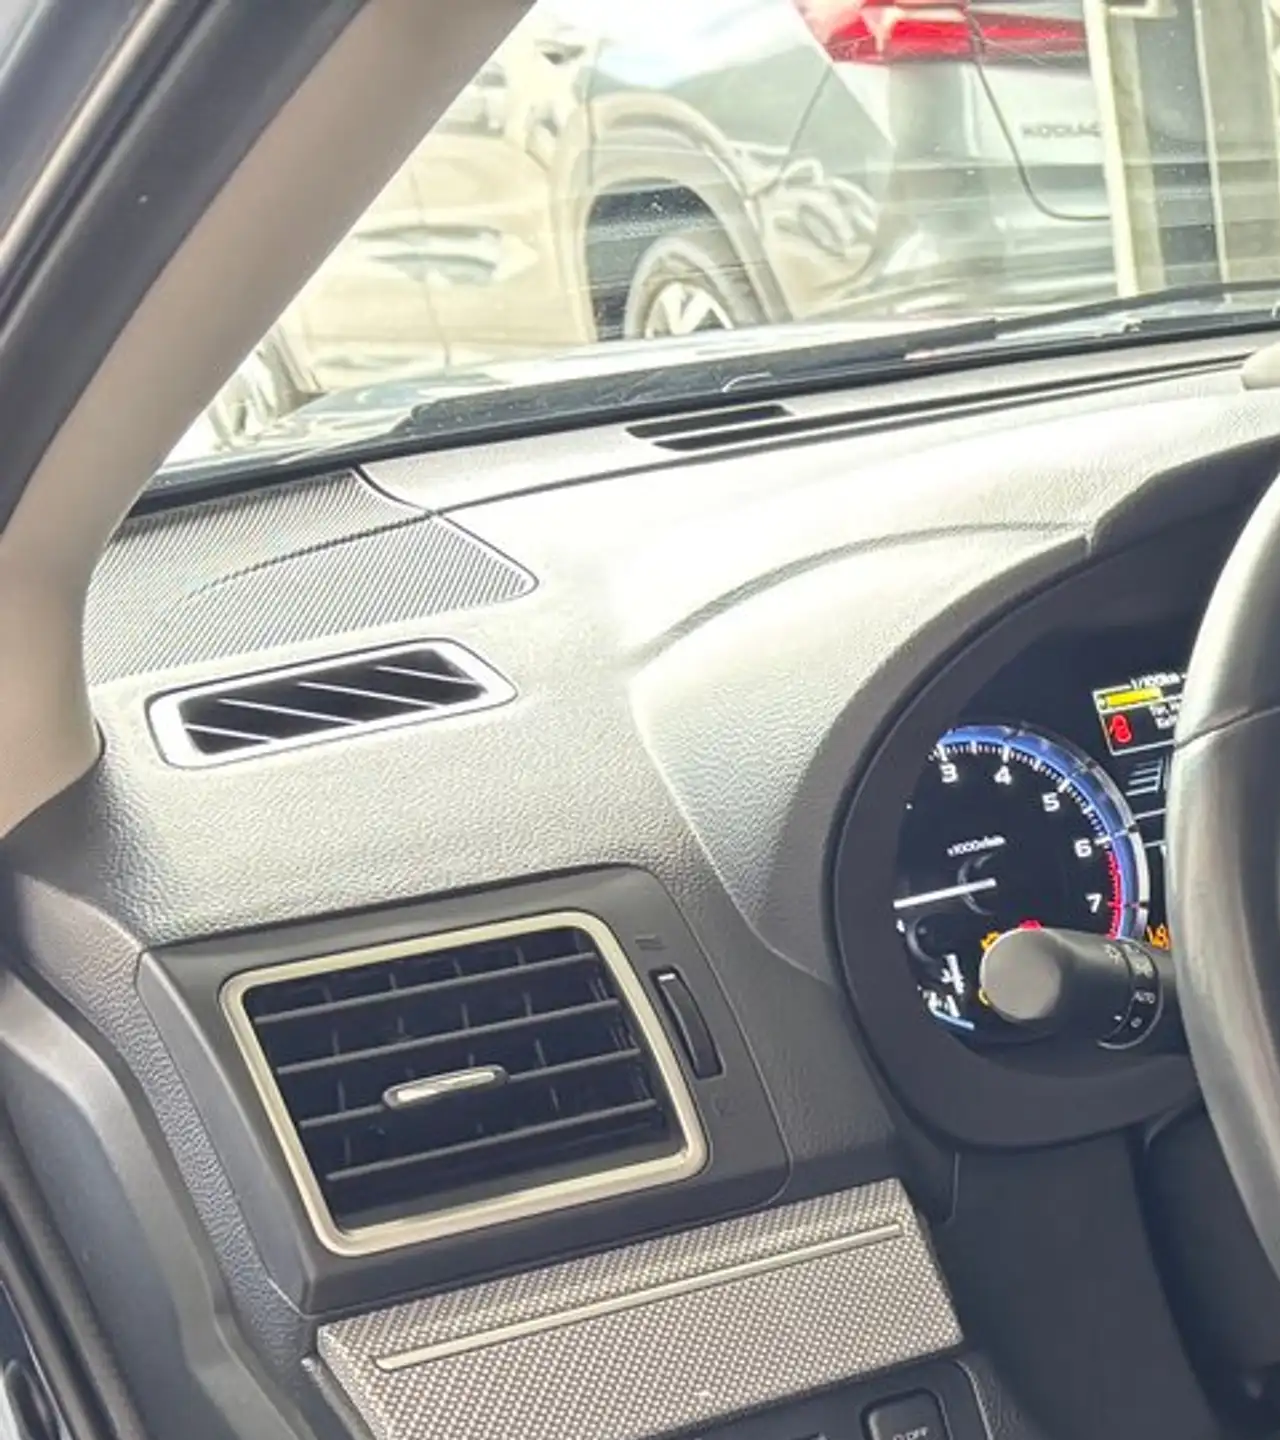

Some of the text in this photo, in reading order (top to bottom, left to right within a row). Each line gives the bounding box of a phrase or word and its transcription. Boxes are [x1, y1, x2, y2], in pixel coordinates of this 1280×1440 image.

[939, 761, 959, 784] 3
[993, 764, 1013, 786] 4
[1041, 792, 1062, 813] 5
[1073, 837, 1093, 858] 6
[1085, 892, 1103, 914] 7
